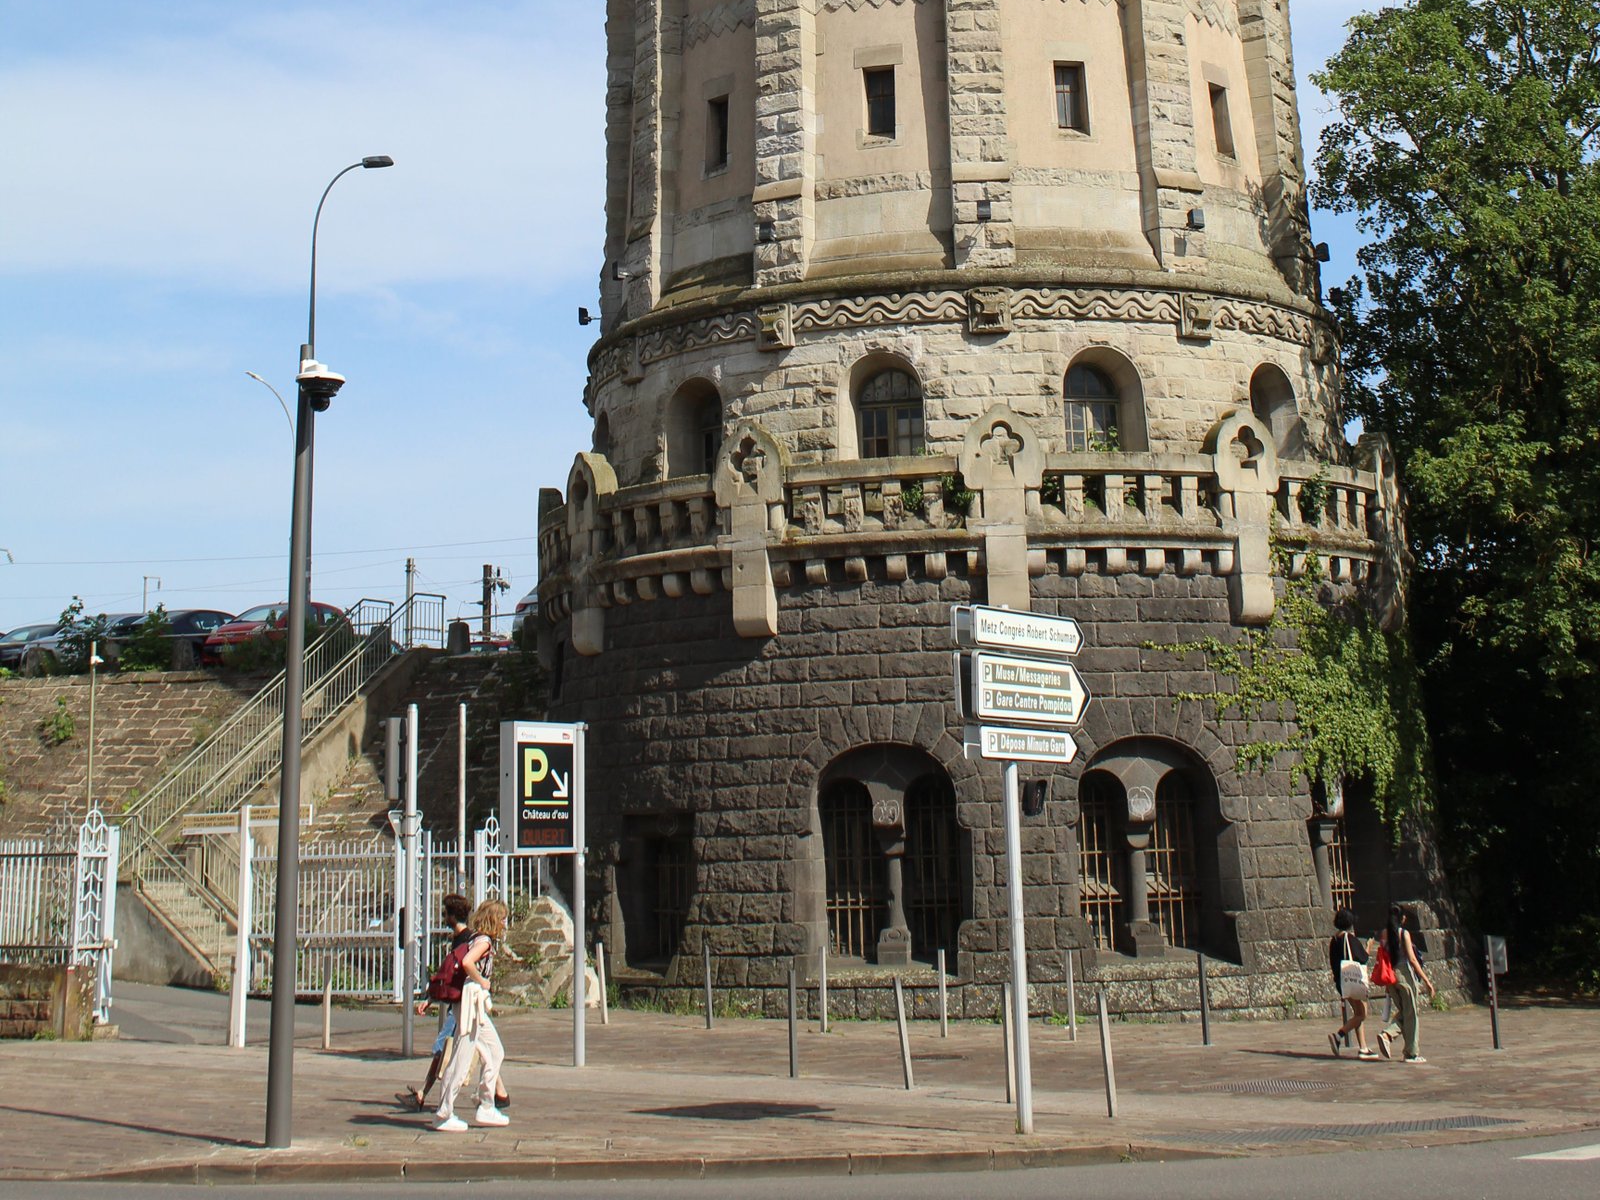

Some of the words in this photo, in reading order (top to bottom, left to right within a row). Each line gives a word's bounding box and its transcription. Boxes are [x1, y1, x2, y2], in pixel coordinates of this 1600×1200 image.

[980, 619, 997, 635] Metz
[999, 621, 1025, 640] Congrès
[1027, 625, 1048, 641] Robert
[1049, 628, 1077, 644] Schuman
[996, 693, 1013, 707] Gare
[1014, 694, 1038, 709] Centre
[1039, 695, 1073, 714] Pompidou
[1000, 734, 1026, 755] Dépose
[1027, 736, 1049, 752] Minute
[1050, 738, 1066, 753] Gare
[524, 747, 549, 797] P
[522, 809, 551, 820] Château
[551, 809, 569, 820] d'eau
[522, 828, 566, 845] OUVERT
